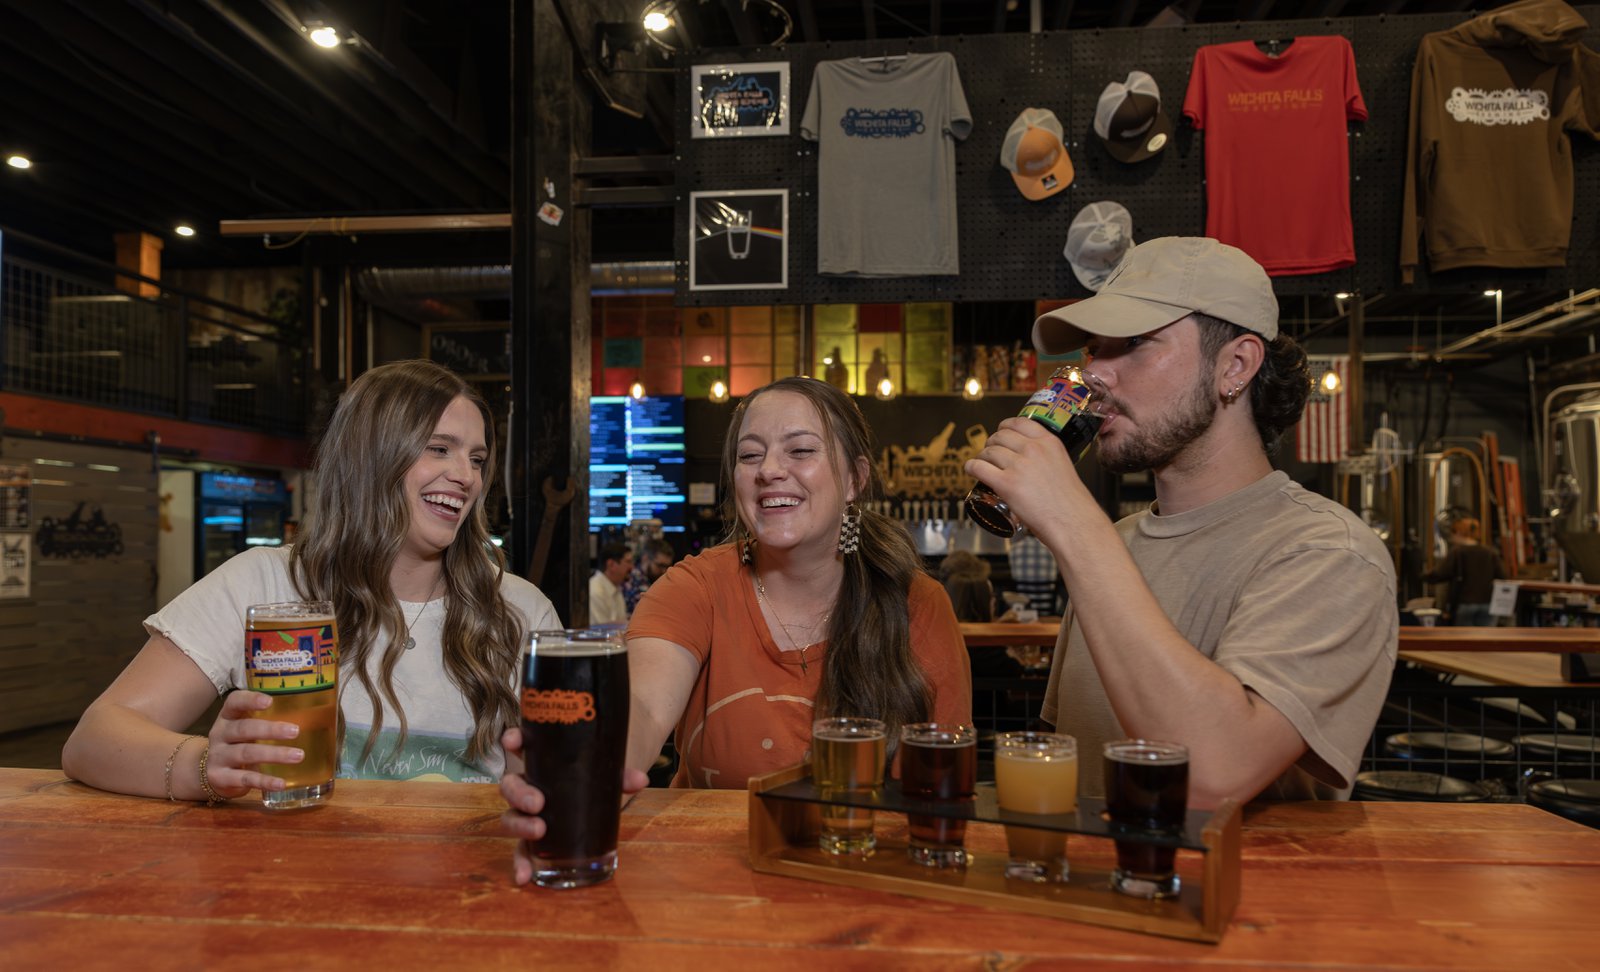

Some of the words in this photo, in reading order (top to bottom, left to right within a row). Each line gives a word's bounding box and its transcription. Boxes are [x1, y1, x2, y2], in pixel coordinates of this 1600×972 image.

[1227, 91, 1281, 105] WICHITA
[1283, 89, 1323, 103] FALLS
[1465, 100, 1501, 111] WICHITA
[1502, 100, 1534, 111] FALLS
[854, 118, 886, 128] WICHITA
[887, 118, 912, 127] FALLS
[904, 464, 960, 477] WICHITA
[552, 701, 579, 710] FALLS
[362, 750, 415, 775] Never
